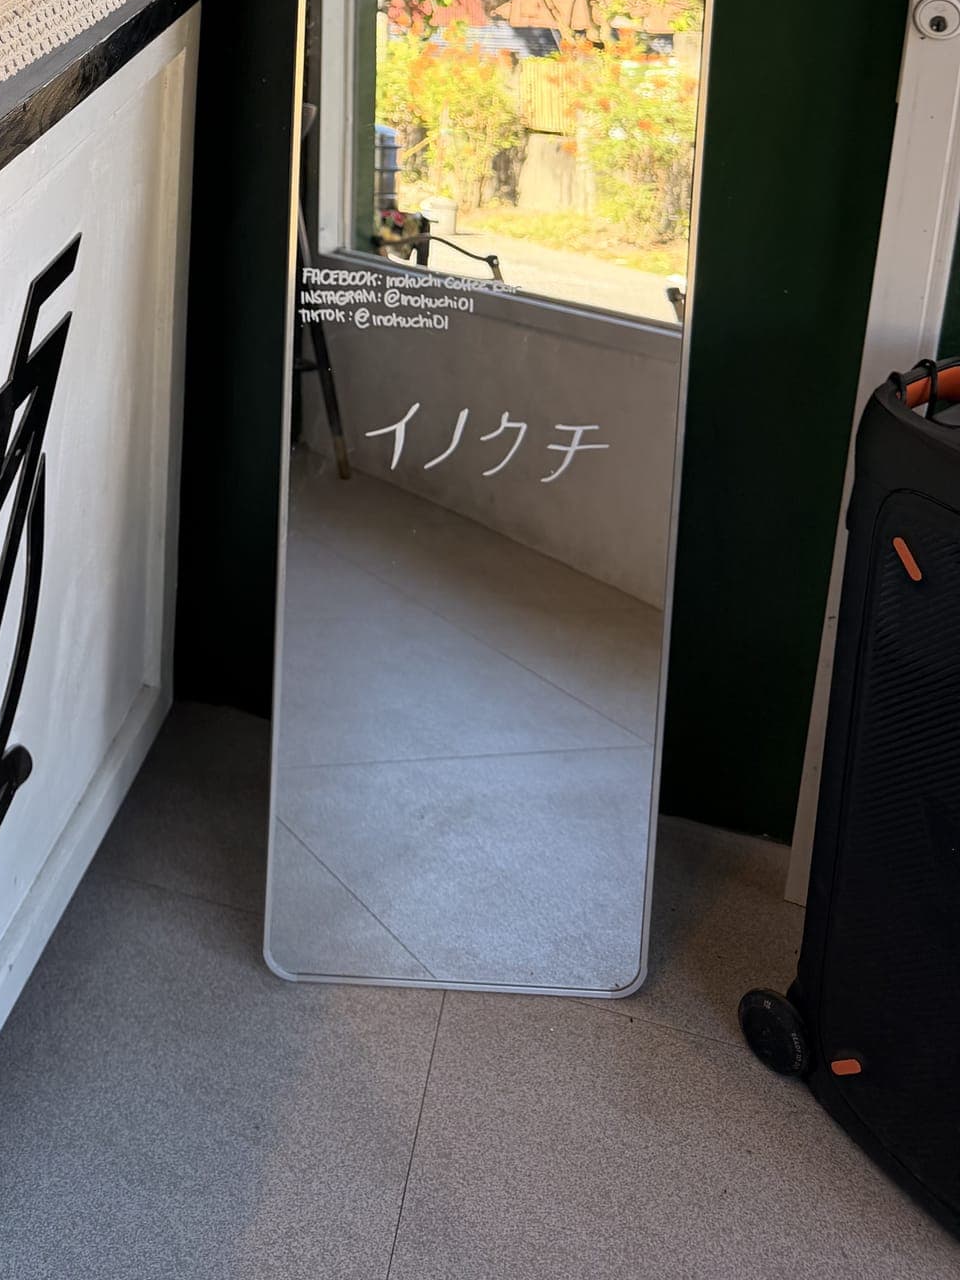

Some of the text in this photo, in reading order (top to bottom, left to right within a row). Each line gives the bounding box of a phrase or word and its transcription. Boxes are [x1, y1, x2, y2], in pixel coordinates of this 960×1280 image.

[302, 268, 382, 286] FACEBOOK:
[300, 289, 382, 305] INSTAGRAM:
[365, 402, 610, 483] イノクチ
